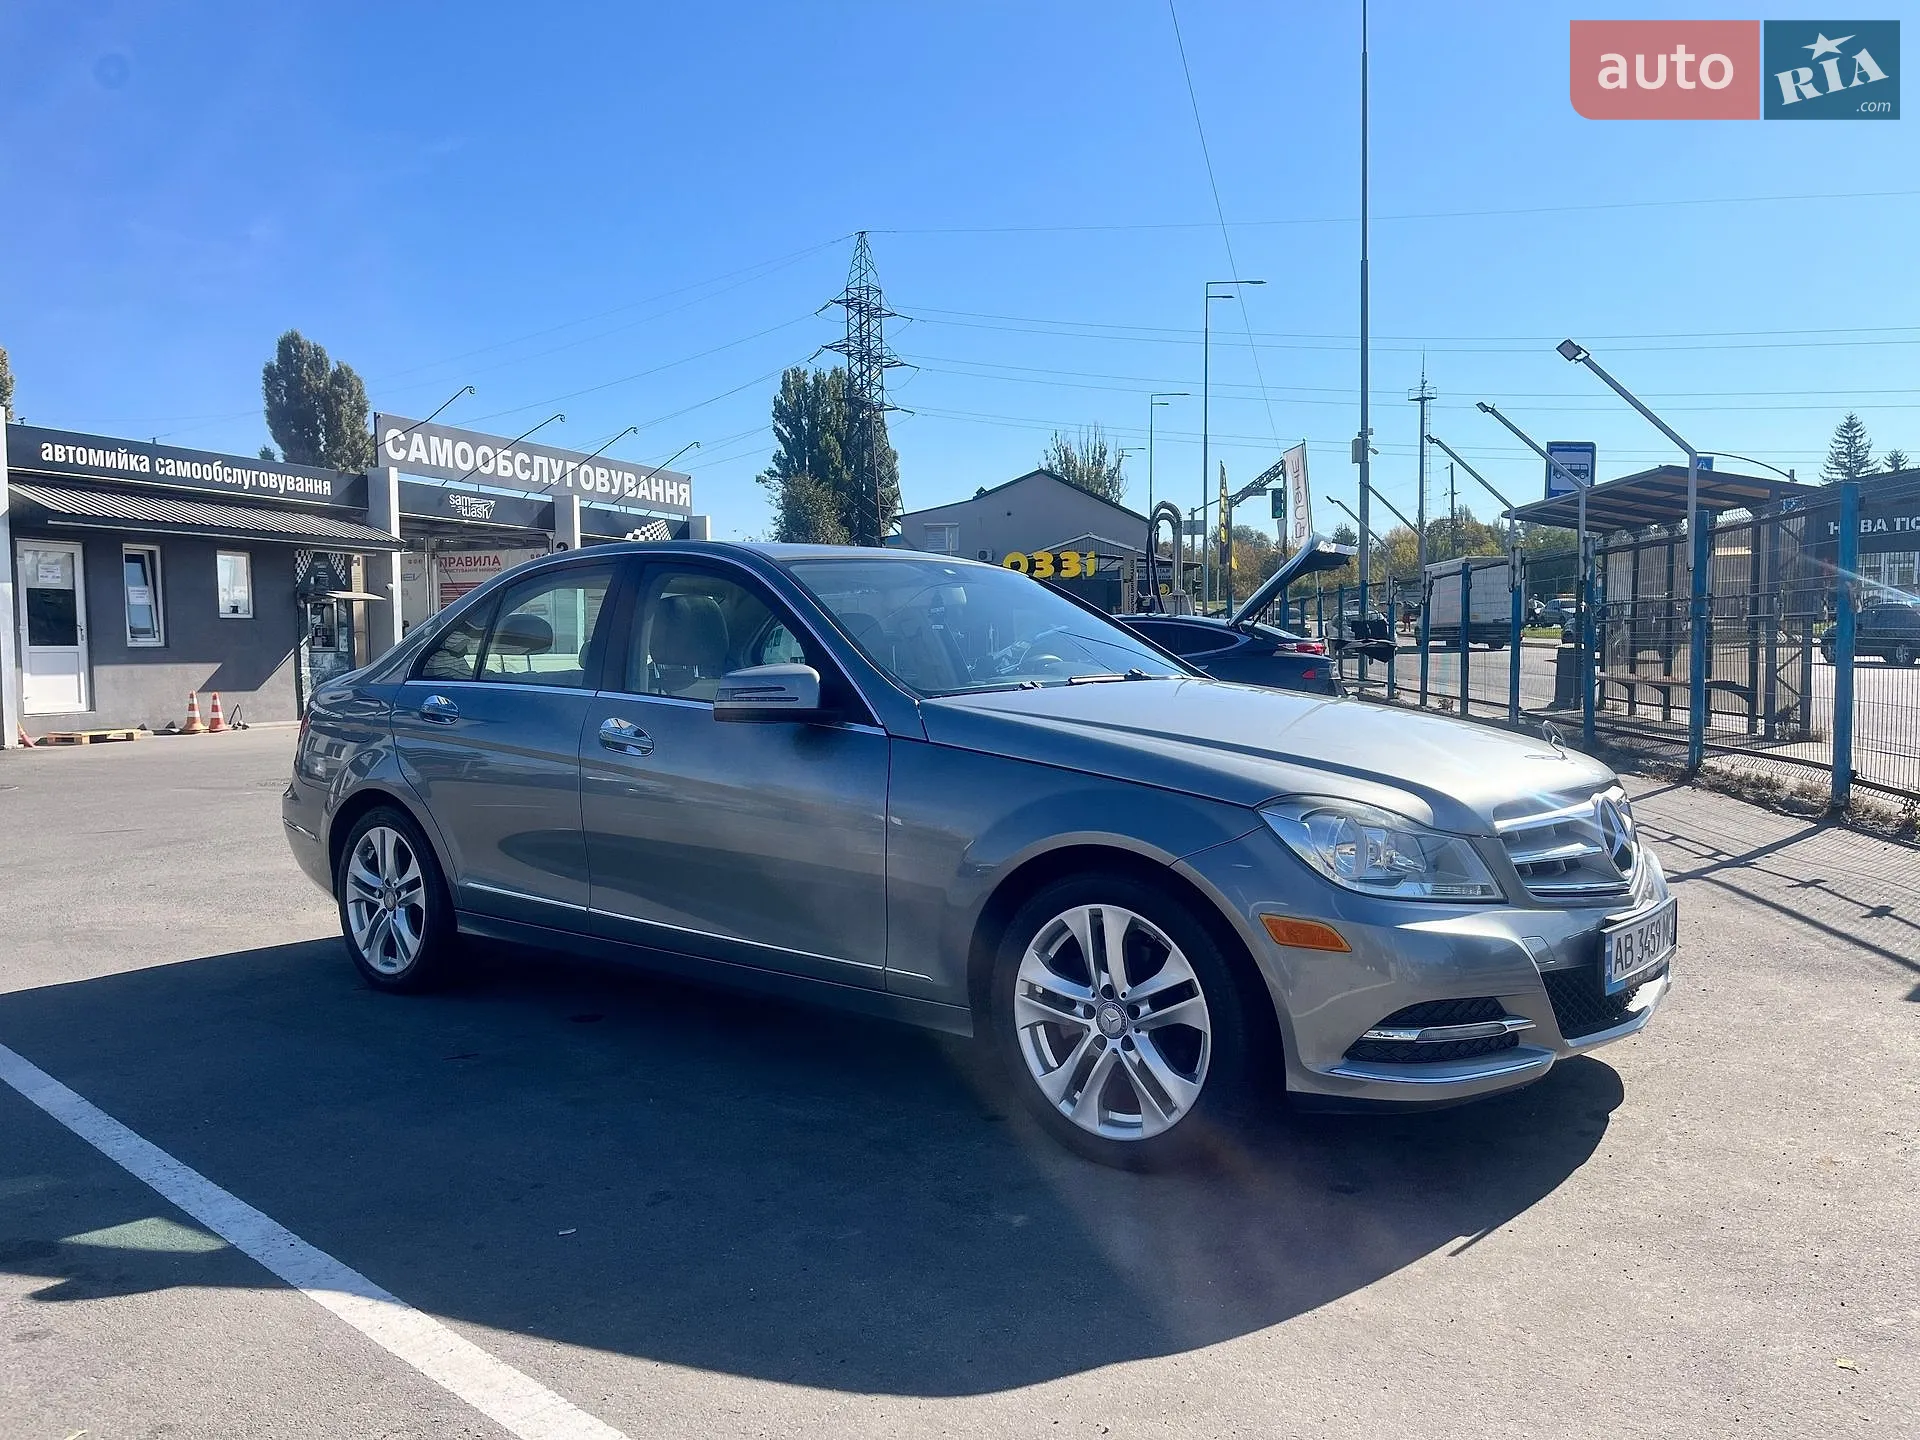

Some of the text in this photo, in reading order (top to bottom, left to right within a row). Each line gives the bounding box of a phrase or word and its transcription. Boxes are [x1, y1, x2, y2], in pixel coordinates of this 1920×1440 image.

[41, 442, 332, 496] автомийка самообслуговування
[384, 428, 691, 507] САМООБСЛУГОВУВАННЯ
[1828, 518, 1889, 535] НВА
[440, 555, 501, 568] ПРАВИЛА
[1614, 933, 1634, 974] AB
[1637, 919, 1661, 962] 3459
